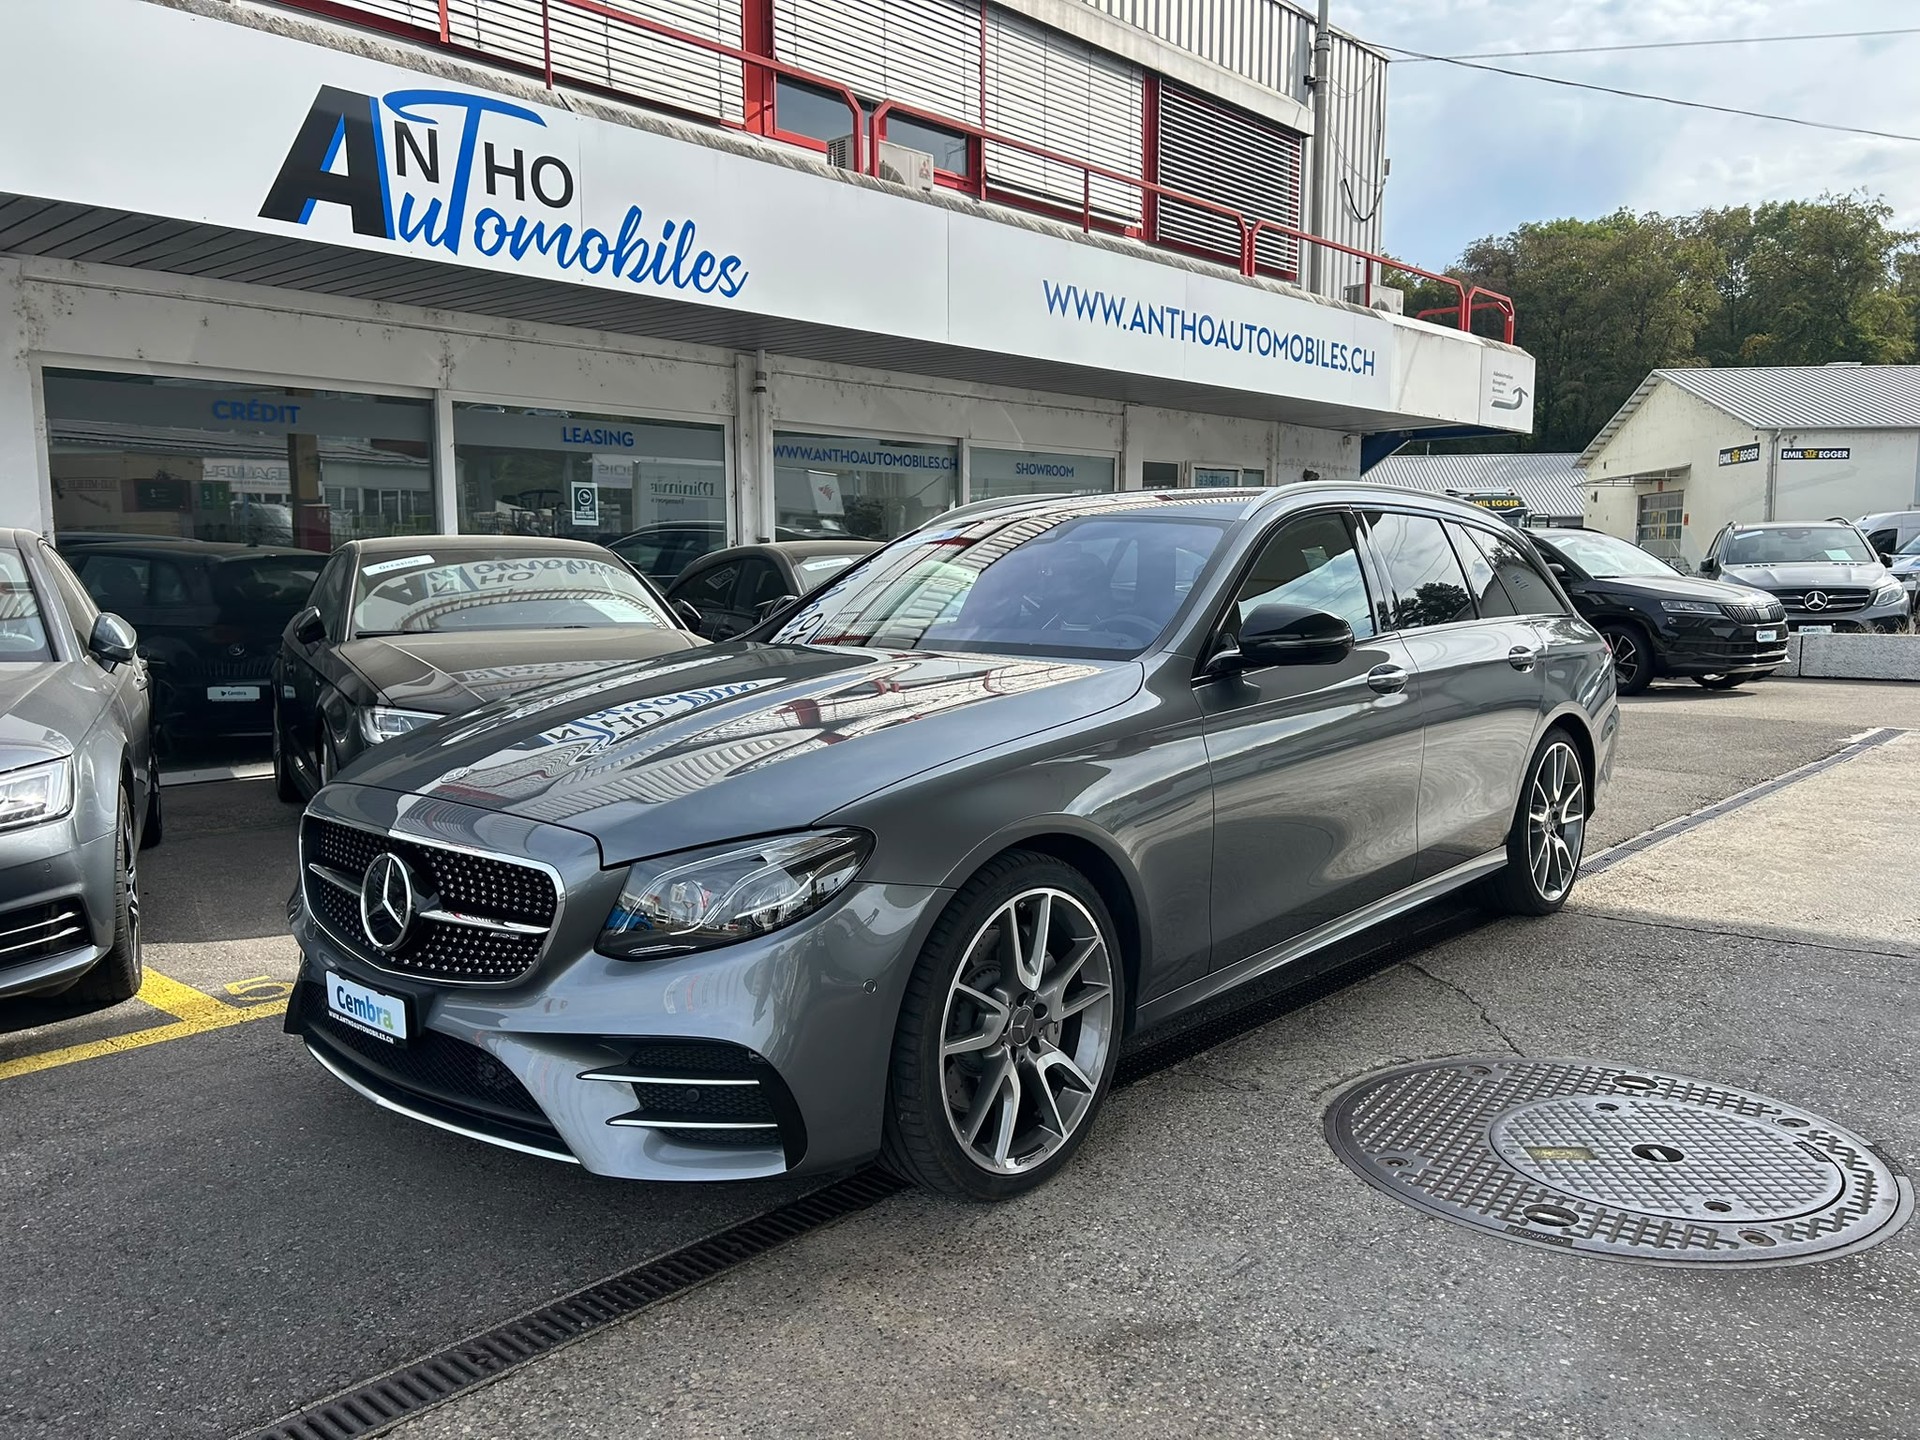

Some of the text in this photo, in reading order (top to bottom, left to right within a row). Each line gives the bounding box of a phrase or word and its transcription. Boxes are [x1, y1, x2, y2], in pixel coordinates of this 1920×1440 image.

[258, 84, 574, 255] ANTHO
[1042, 279, 1375, 376] WWW.ANTHOAUTOMOBILES.CH
[212, 399, 301, 425] CRÉDIT
[563, 427, 634, 447] LEASING
[773, 445, 959, 470] WWW.ANTHOAUTOMOBILES.CH
[1719, 448, 1759, 464] EMIL EGGER
[1783, 451, 1849, 459] EMIL EGGER
[1015, 462, 1075, 478] SHOWROOM
[337, 985, 394, 1030] Cembra
[328, 1009, 395, 1045] WWW.ANTHOAUTOMOBILES.CH
